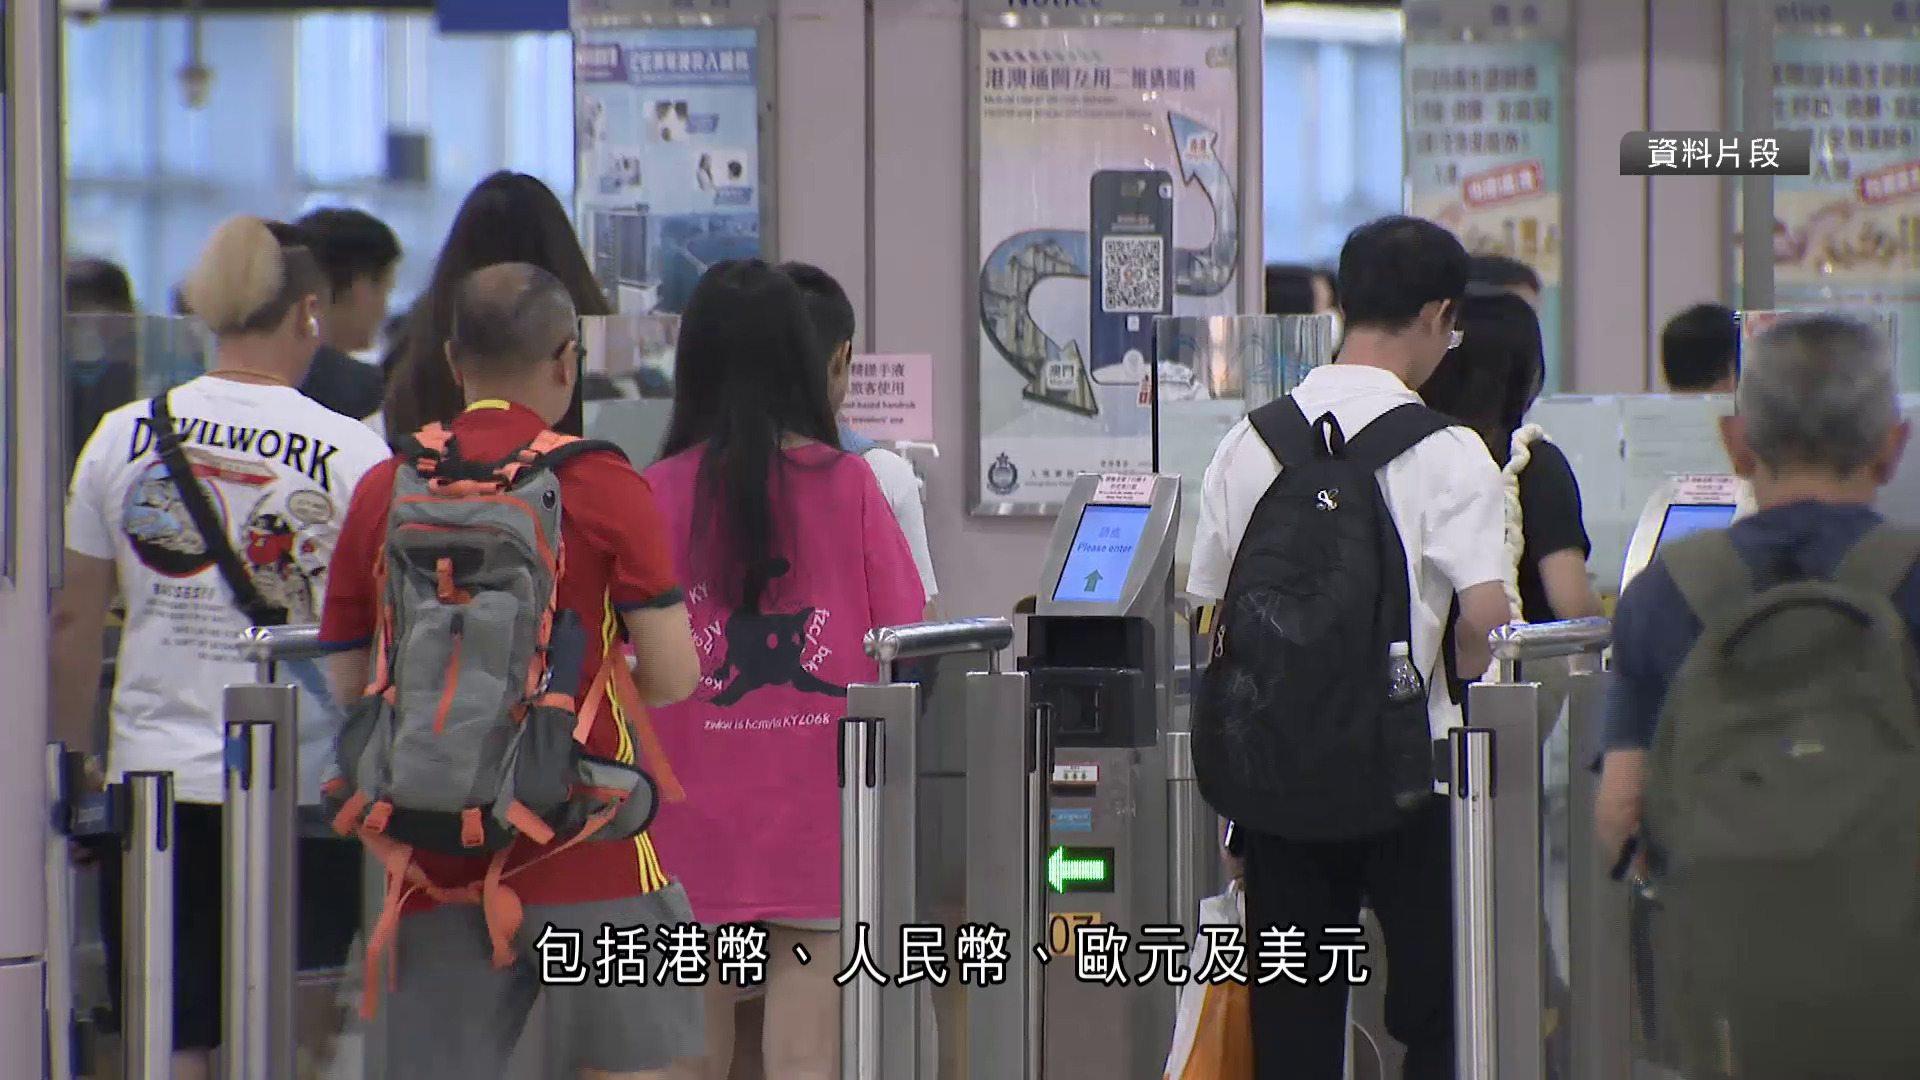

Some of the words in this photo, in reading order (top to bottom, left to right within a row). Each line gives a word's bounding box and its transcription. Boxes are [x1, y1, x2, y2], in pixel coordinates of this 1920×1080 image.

[127, 416, 339, 491] DVILWORK
[1077, 542, 1107, 553] Please
[1108, 543, 1133, 553] enter
